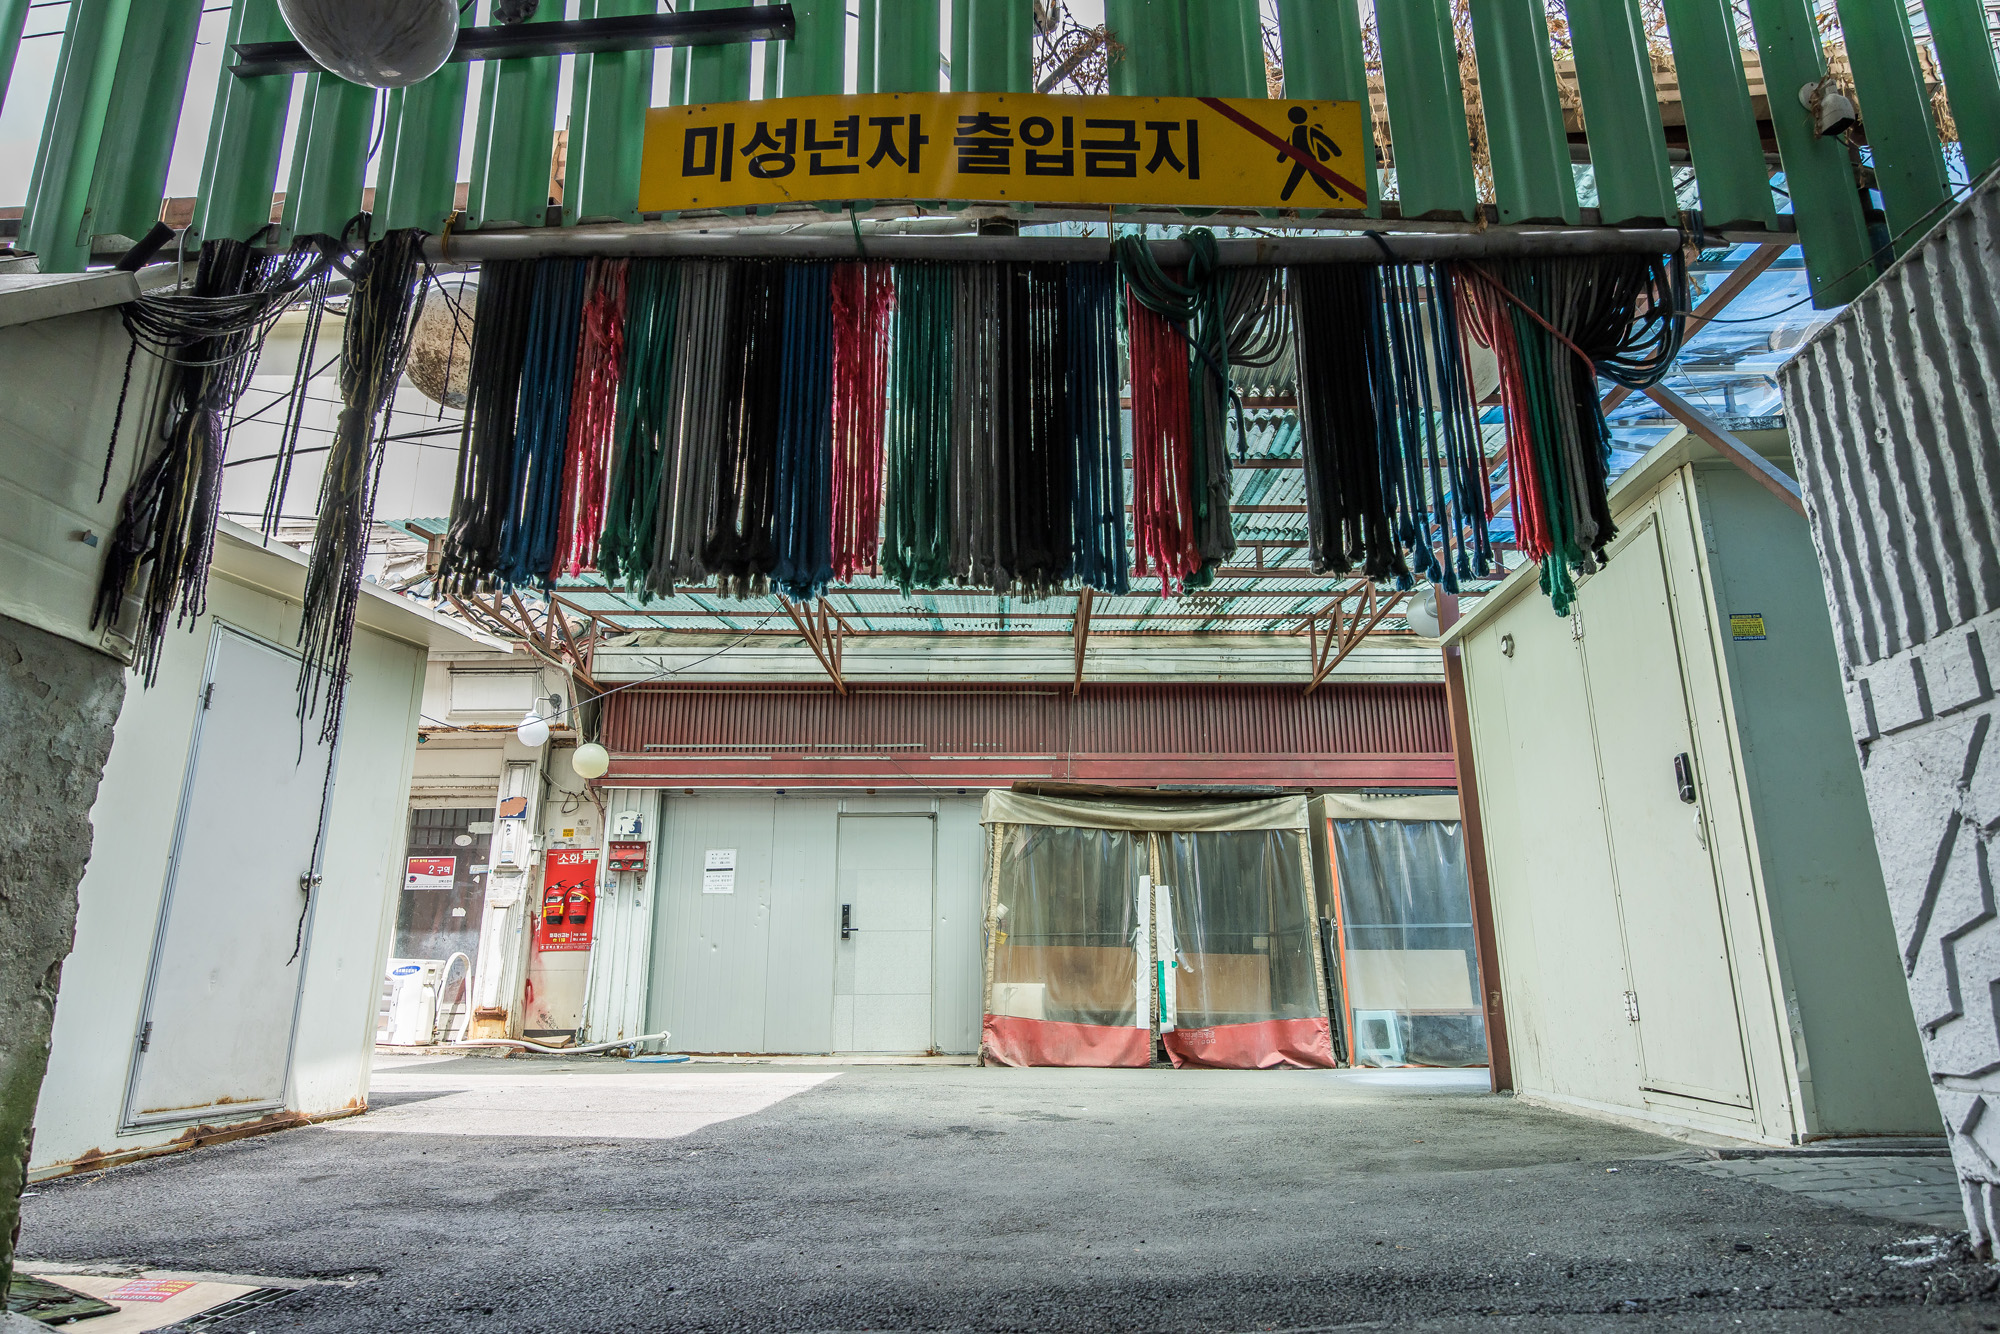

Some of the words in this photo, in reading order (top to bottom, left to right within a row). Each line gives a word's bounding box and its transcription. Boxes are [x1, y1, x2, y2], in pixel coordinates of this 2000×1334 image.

[682, 114, 929, 182] 미성년자
[953, 112, 1200, 180] 출입금지
[428, 865, 435, 874] 2
[437, 866, 451, 875] 구역
